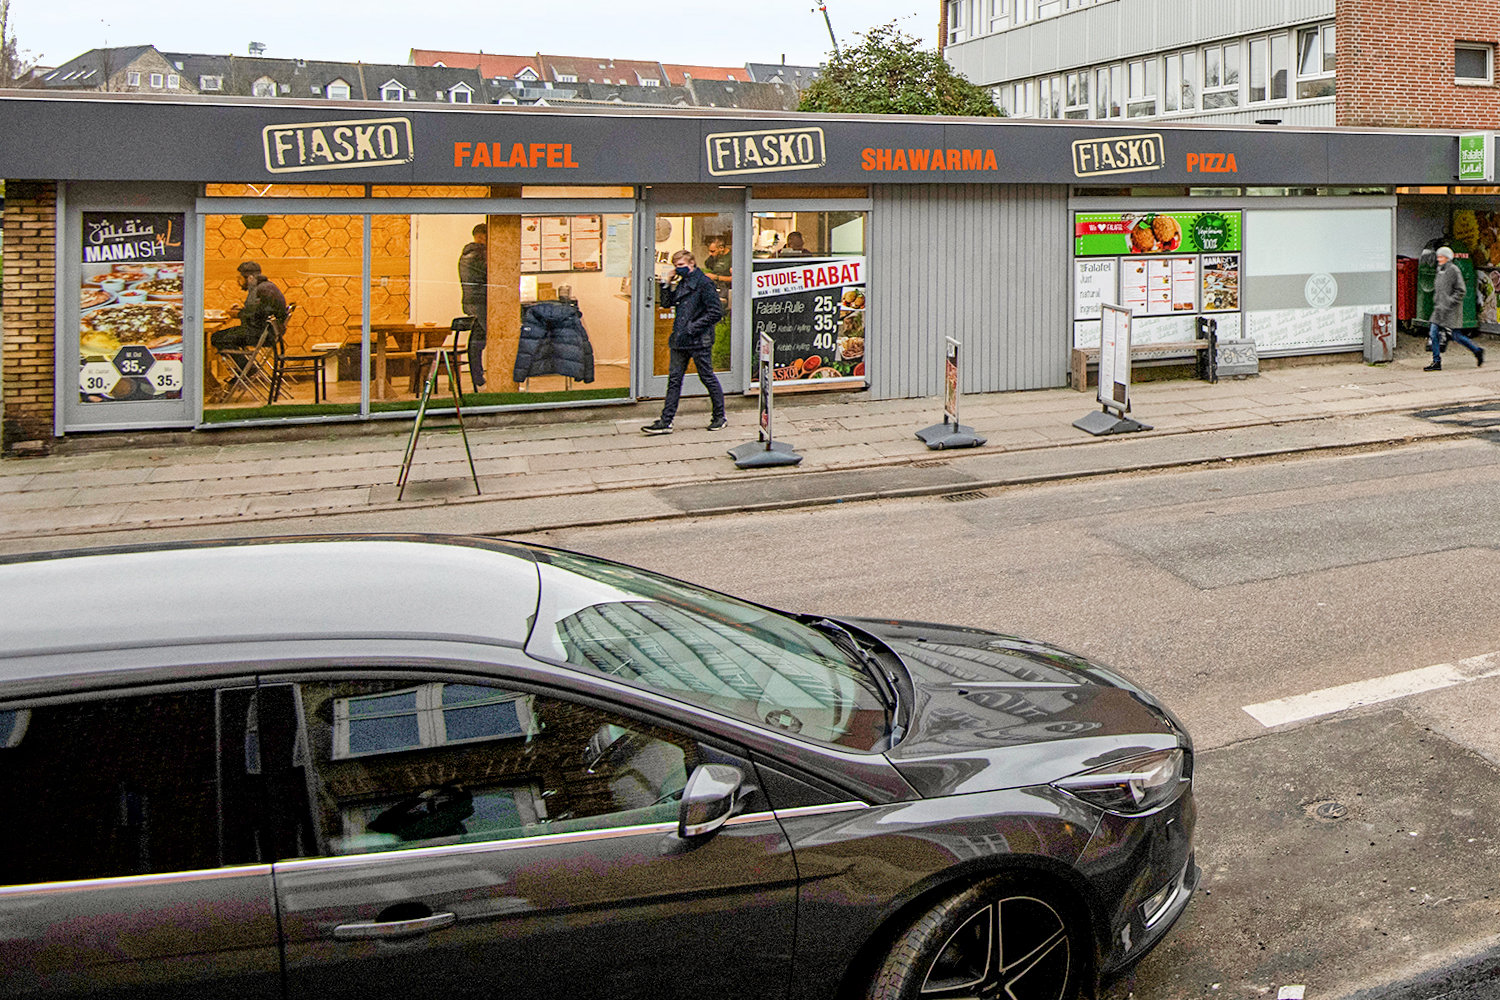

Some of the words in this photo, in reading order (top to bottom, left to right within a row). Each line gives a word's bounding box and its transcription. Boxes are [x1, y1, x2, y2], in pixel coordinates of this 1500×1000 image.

[274, 125, 399, 165] FIASKO
[454, 142, 579, 168] FALAFEL
[714, 134, 815, 168] FIASKO
[1078, 139, 1156, 171] FIASKO
[861, 148, 999, 171] SHAWARMA
[1186, 153, 1238, 173] PIZZA
[85, 241, 166, 262] MANAISH
[122, 360, 146, 373] 35,-
[87, 377, 110, 389] 30,-
[157, 375, 179, 387] 35,-
